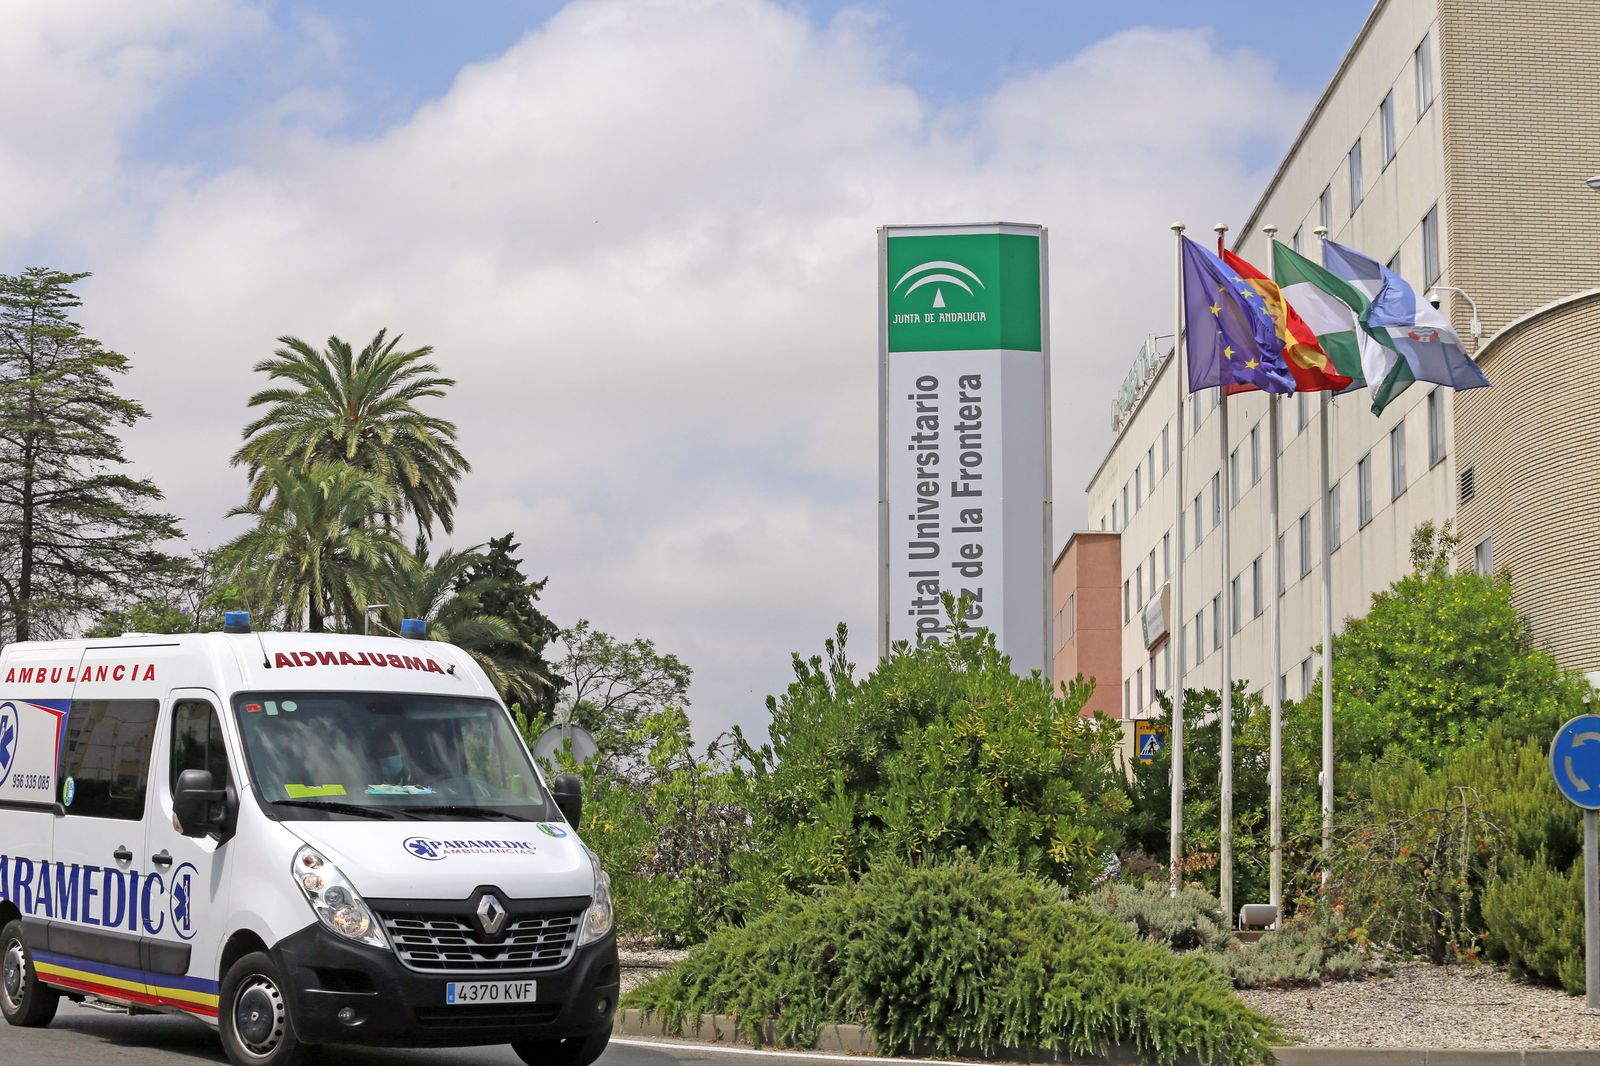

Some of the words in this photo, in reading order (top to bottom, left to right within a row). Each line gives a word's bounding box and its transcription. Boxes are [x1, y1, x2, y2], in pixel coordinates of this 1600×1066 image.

[892, 313, 921, 324] JUNTA
[924, 312, 935, 323] DE
[951, 374, 983, 498] Frontera
[907, 375, 940, 560] Universitario
[951, 508, 984, 533] la
[951, 543, 984, 578] de
[5, 663, 156, 684] AMBULANCIA
[12, 774, 24, 788] 956
[25, 774, 37, 789] 335
[37, 775, 50, 790] 085
[428, 840, 537, 850] PARAMEDIC
[443, 848, 536, 856] AMBULANCIAS
[0, 855, 164, 935] ARAMEDIC
[458, 984, 499, 1001] 4370
[504, 983, 533, 1000] KVF
